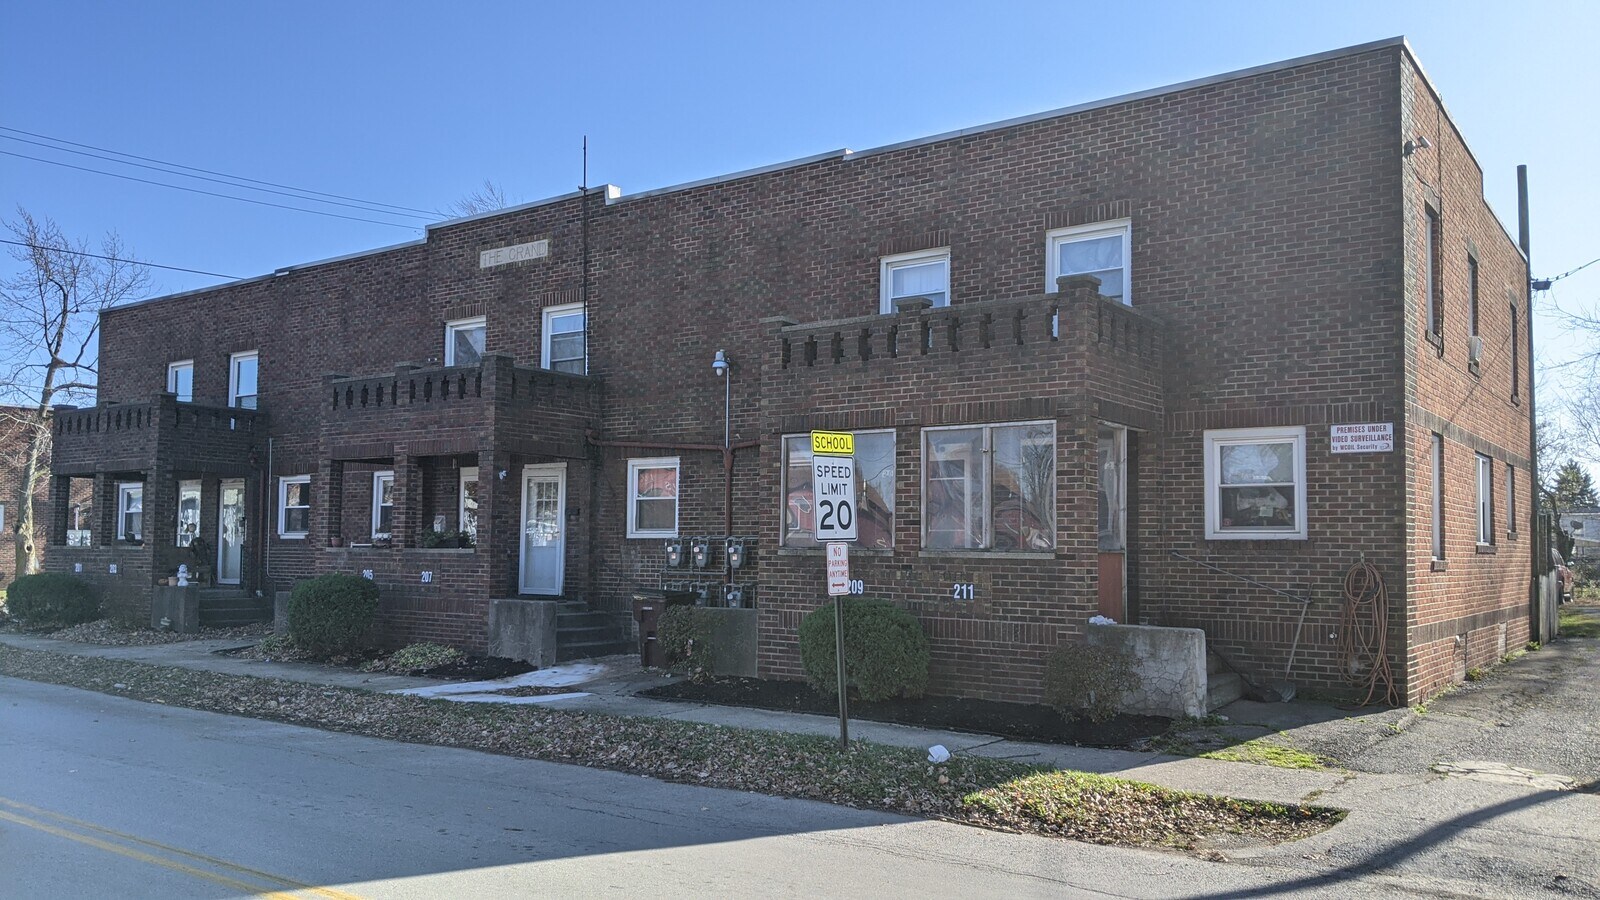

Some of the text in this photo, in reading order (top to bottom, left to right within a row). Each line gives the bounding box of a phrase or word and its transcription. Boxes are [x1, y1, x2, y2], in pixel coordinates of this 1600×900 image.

[482, 250, 503, 266] THE
[815, 436, 851, 450] SCHOOL
[1350, 434, 1392, 442] SURVEILLANCE
[817, 465, 851, 478] SPEED
[821, 483, 847, 495] LIMIT
[819, 500, 852, 530] 20
[833, 547, 841, 556] NO
[421, 571, 432, 583] 207
[953, 583, 974, 599] 211
